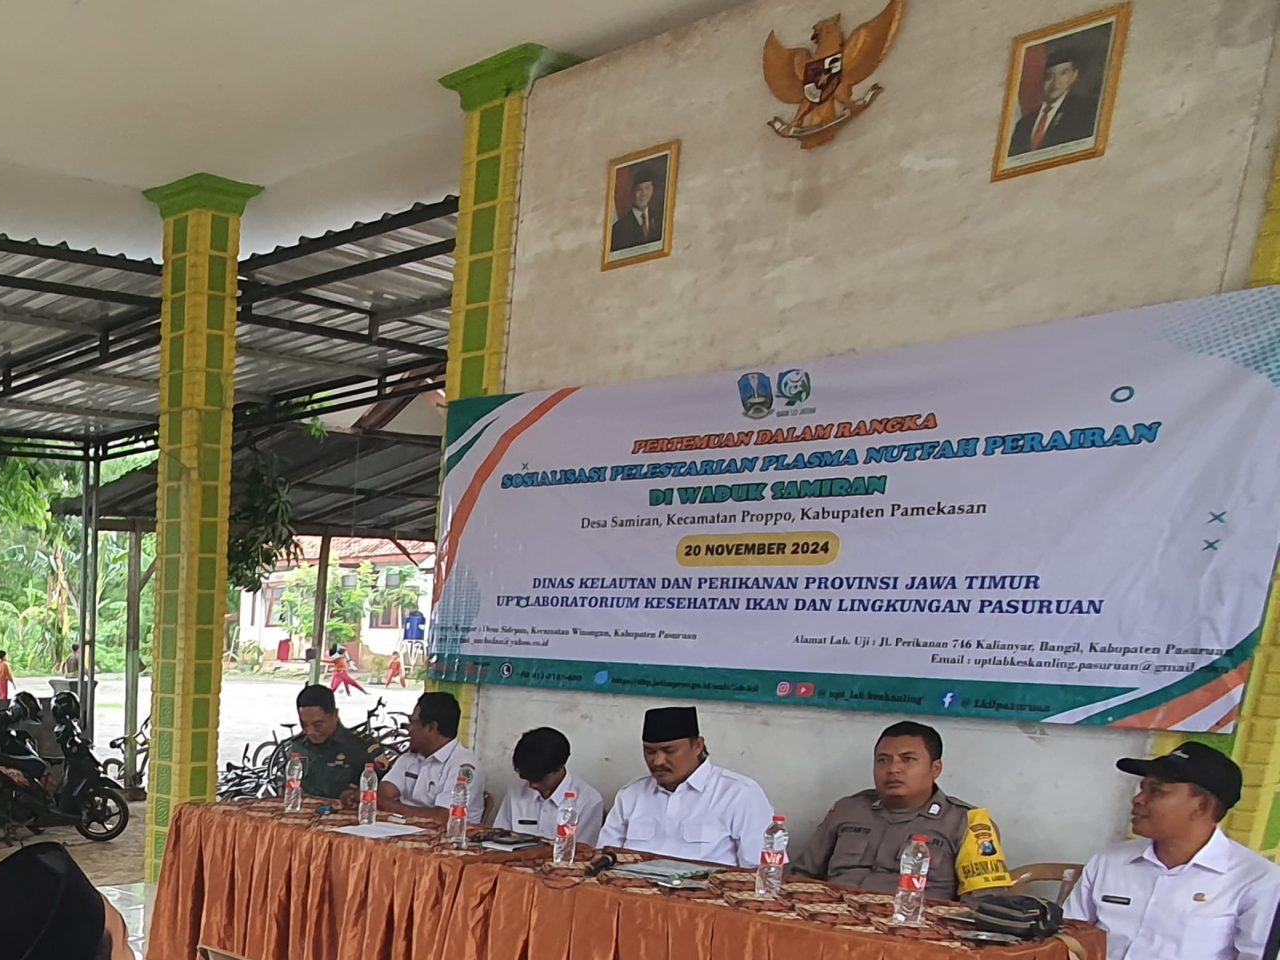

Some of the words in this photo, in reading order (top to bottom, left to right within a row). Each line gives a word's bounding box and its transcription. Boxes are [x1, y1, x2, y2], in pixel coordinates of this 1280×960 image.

[631, 431, 753, 455] PERTEMUAN
[754, 424, 835, 446] DALAM
[832, 413, 938, 440] RANGKA
[501, 466, 607, 489] SOSIALISASI
[610, 456, 761, 482] PELESTARIAN
[761, 449, 858, 473] PLASMA
[863, 436, 980, 465] NUTFAH
[983, 421, 1162, 456] PERAIRAN
[648, 488, 673, 507] DI
[676, 482, 768, 506] WADUK
[771, 475, 888, 501] SAMIRAN
[581, 517, 608, 529] Desa
[610, 514, 663, 529] Samiran,
[666, 510, 737, 526] Kecamatan
[741, 508, 796, 526] Proppo,
[800, 502, 885, 521] Kabupaten
[889, 500, 987, 518] Pamekasan
[683, 543, 702, 557] 20
[704, 541, 787, 556] NOVEMBER
[790, 540, 830, 556] 2024
[532, 577, 576, 590] DINAS
[578, 577, 657, 590] KELAUTAN
[661, 577, 691, 591] DAN
[697, 576, 799, 591] PERIKANAN
[804, 576, 899, 591] PROVINSI
[904, 576, 957, 591] JAWA
[964, 574, 1041, 590] TIMUR
[643, 597, 740, 610] KESEHATAN
[744, 597, 791, 611] IKAN
[793, 598, 832, 613] DAN
[837, 598, 972, 614] LINGKUNGAN
[977, 599, 1104, 616] PASURUAN
[792, 635, 827, 645] Alamat
[829, 635, 850, 645] Lab.
[854, 636, 870, 648] Uji
[895, 637, 949, 649] Perikanan
[1039, 641, 1084, 654] Bangil,
[1088, 642, 1161, 656] Kabupaten
[931, 653, 964, 665] Email
